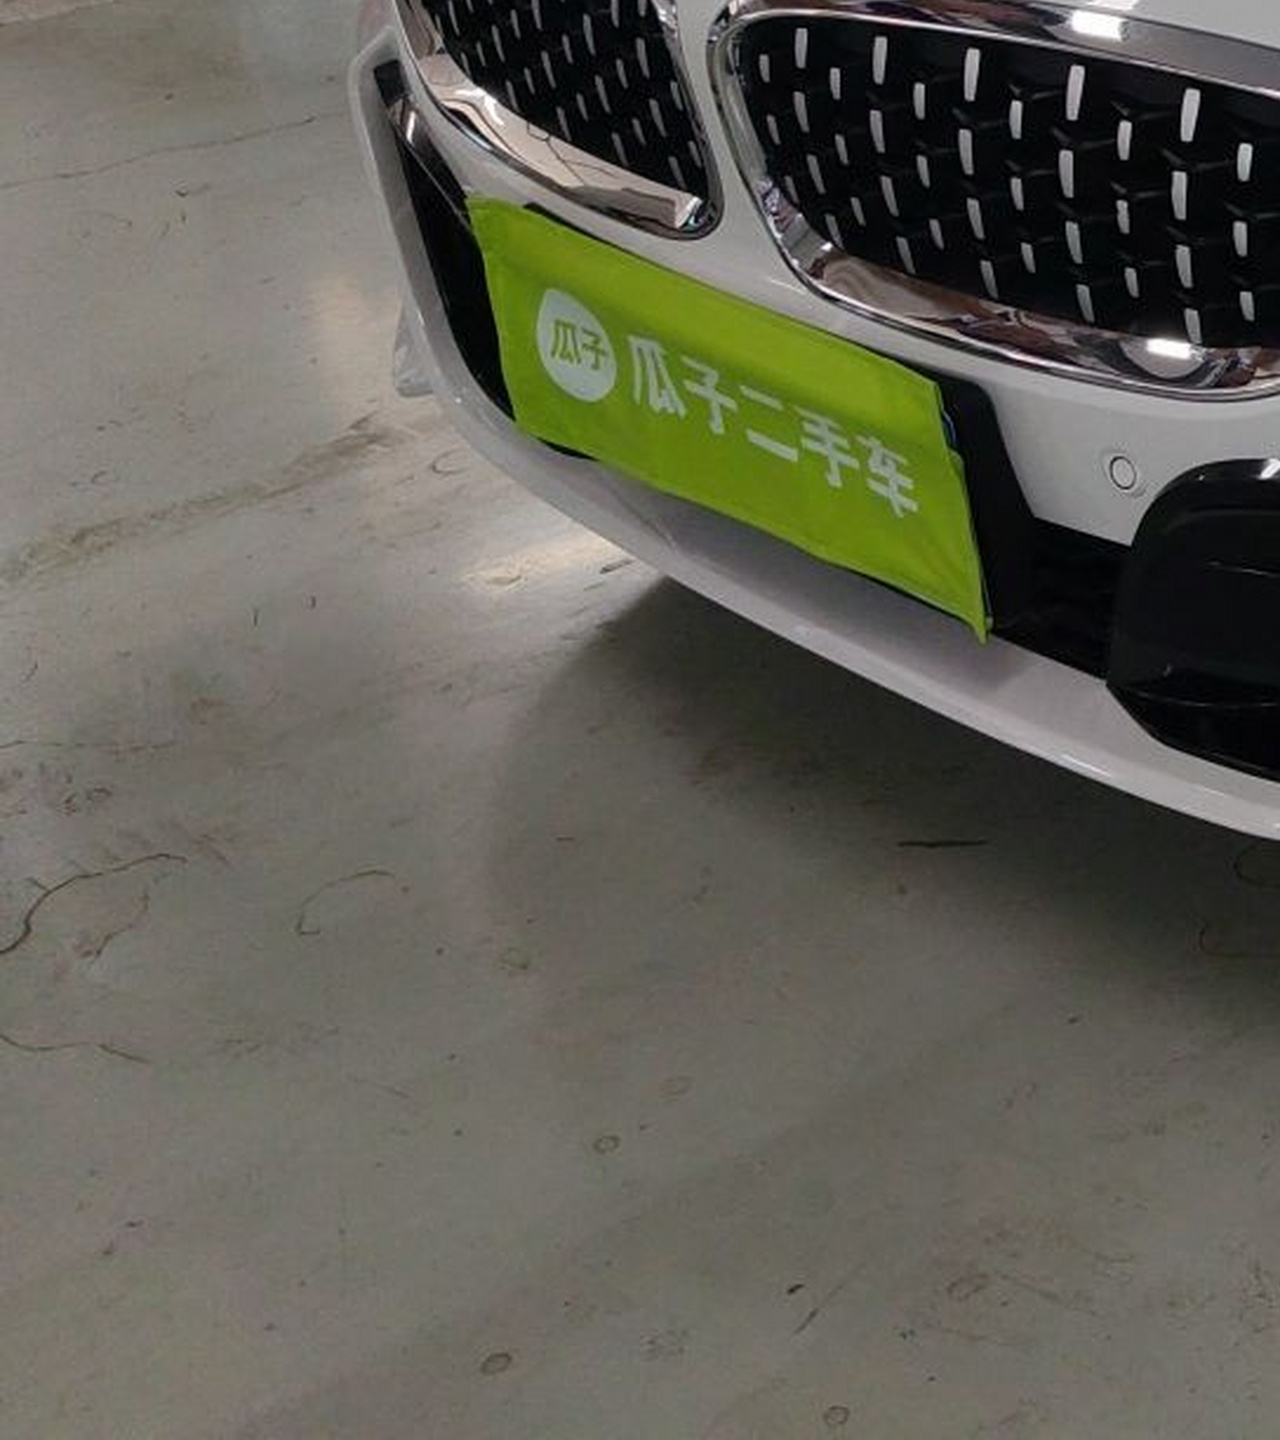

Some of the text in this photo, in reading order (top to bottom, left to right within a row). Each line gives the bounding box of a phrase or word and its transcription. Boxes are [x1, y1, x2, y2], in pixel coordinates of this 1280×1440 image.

[549, 319, 609, 371] 瓜子
[626, 333, 919, 518] 瓜子二手车
